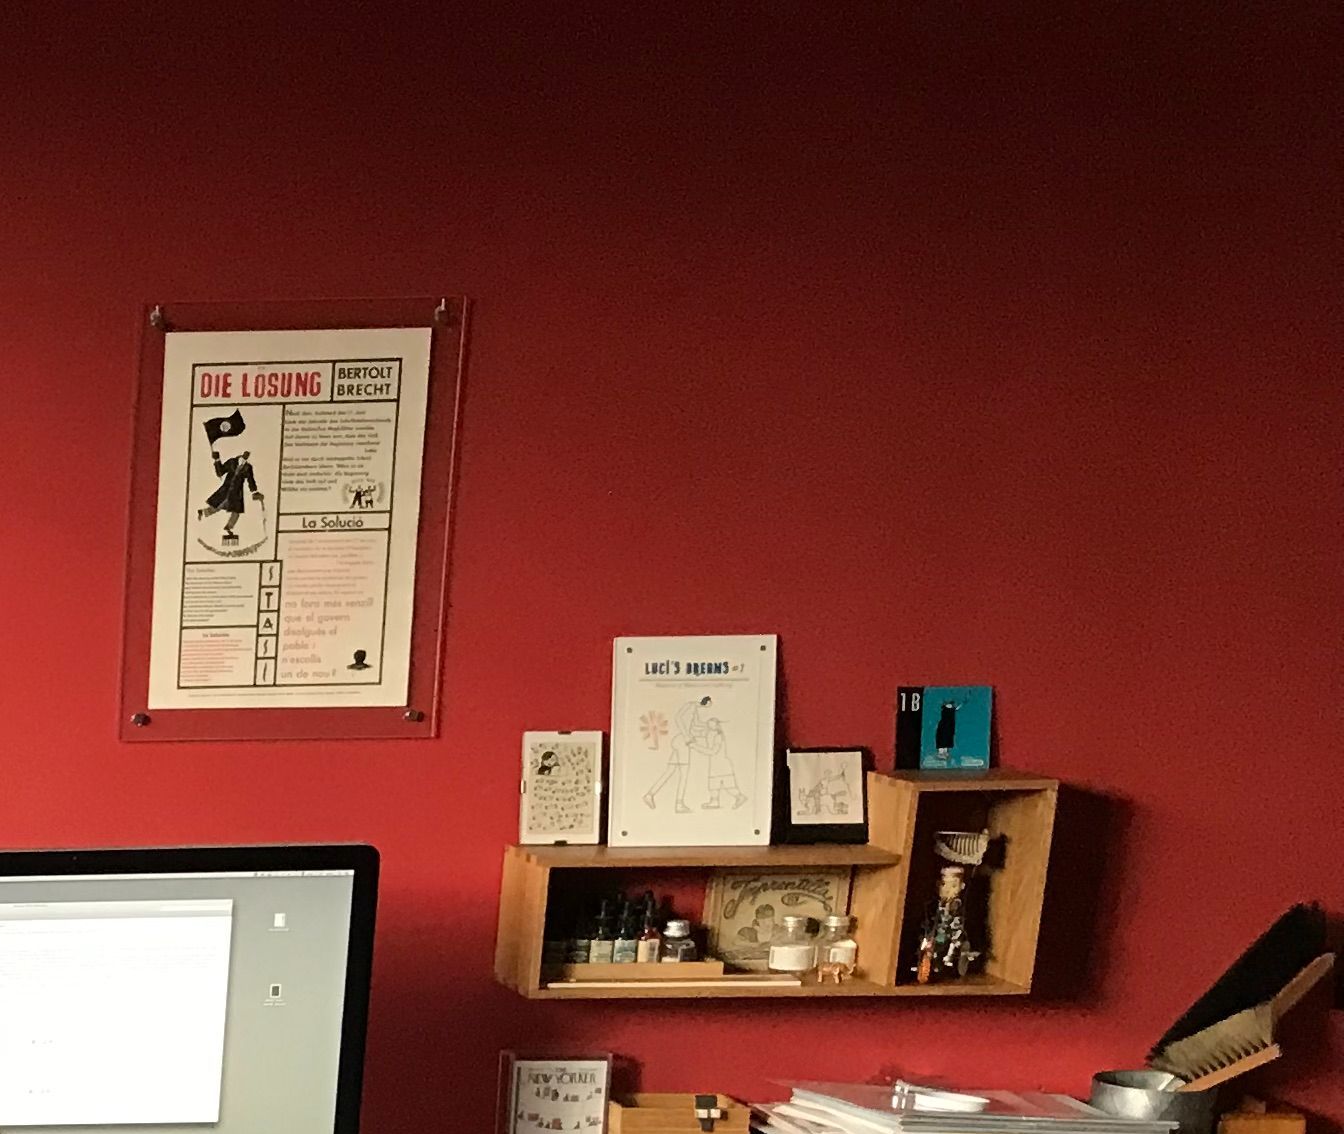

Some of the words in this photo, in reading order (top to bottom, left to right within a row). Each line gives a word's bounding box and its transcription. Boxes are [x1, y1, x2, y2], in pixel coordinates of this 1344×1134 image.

[337, 366, 393, 380] BERTOLT
[200, 372, 232, 399] DIE
[336, 383, 392, 396] BRECHT
[302, 516, 317, 529] La
